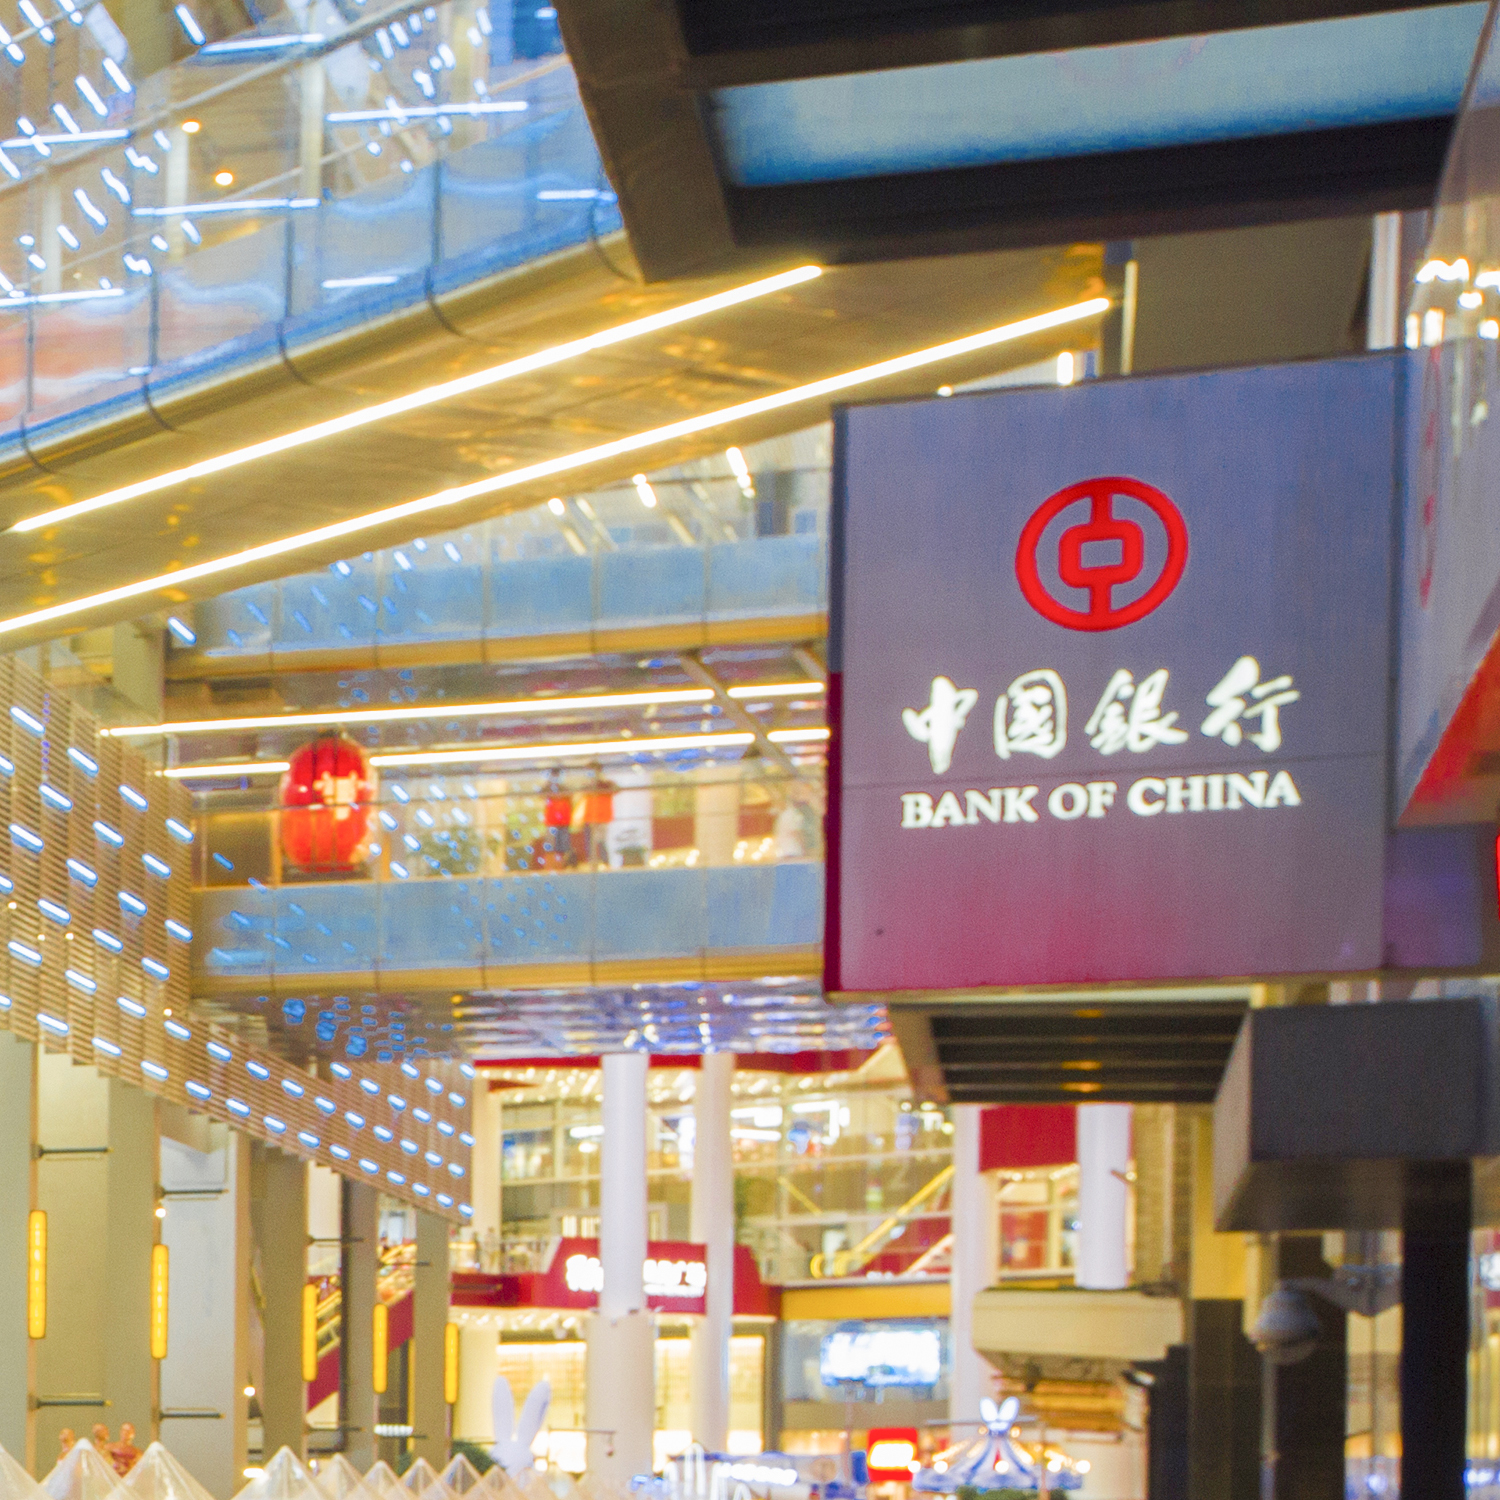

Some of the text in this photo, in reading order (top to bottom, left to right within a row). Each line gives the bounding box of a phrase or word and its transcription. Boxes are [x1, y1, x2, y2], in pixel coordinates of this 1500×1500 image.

[901, 770, 1302, 829] BANK OF CHINA
